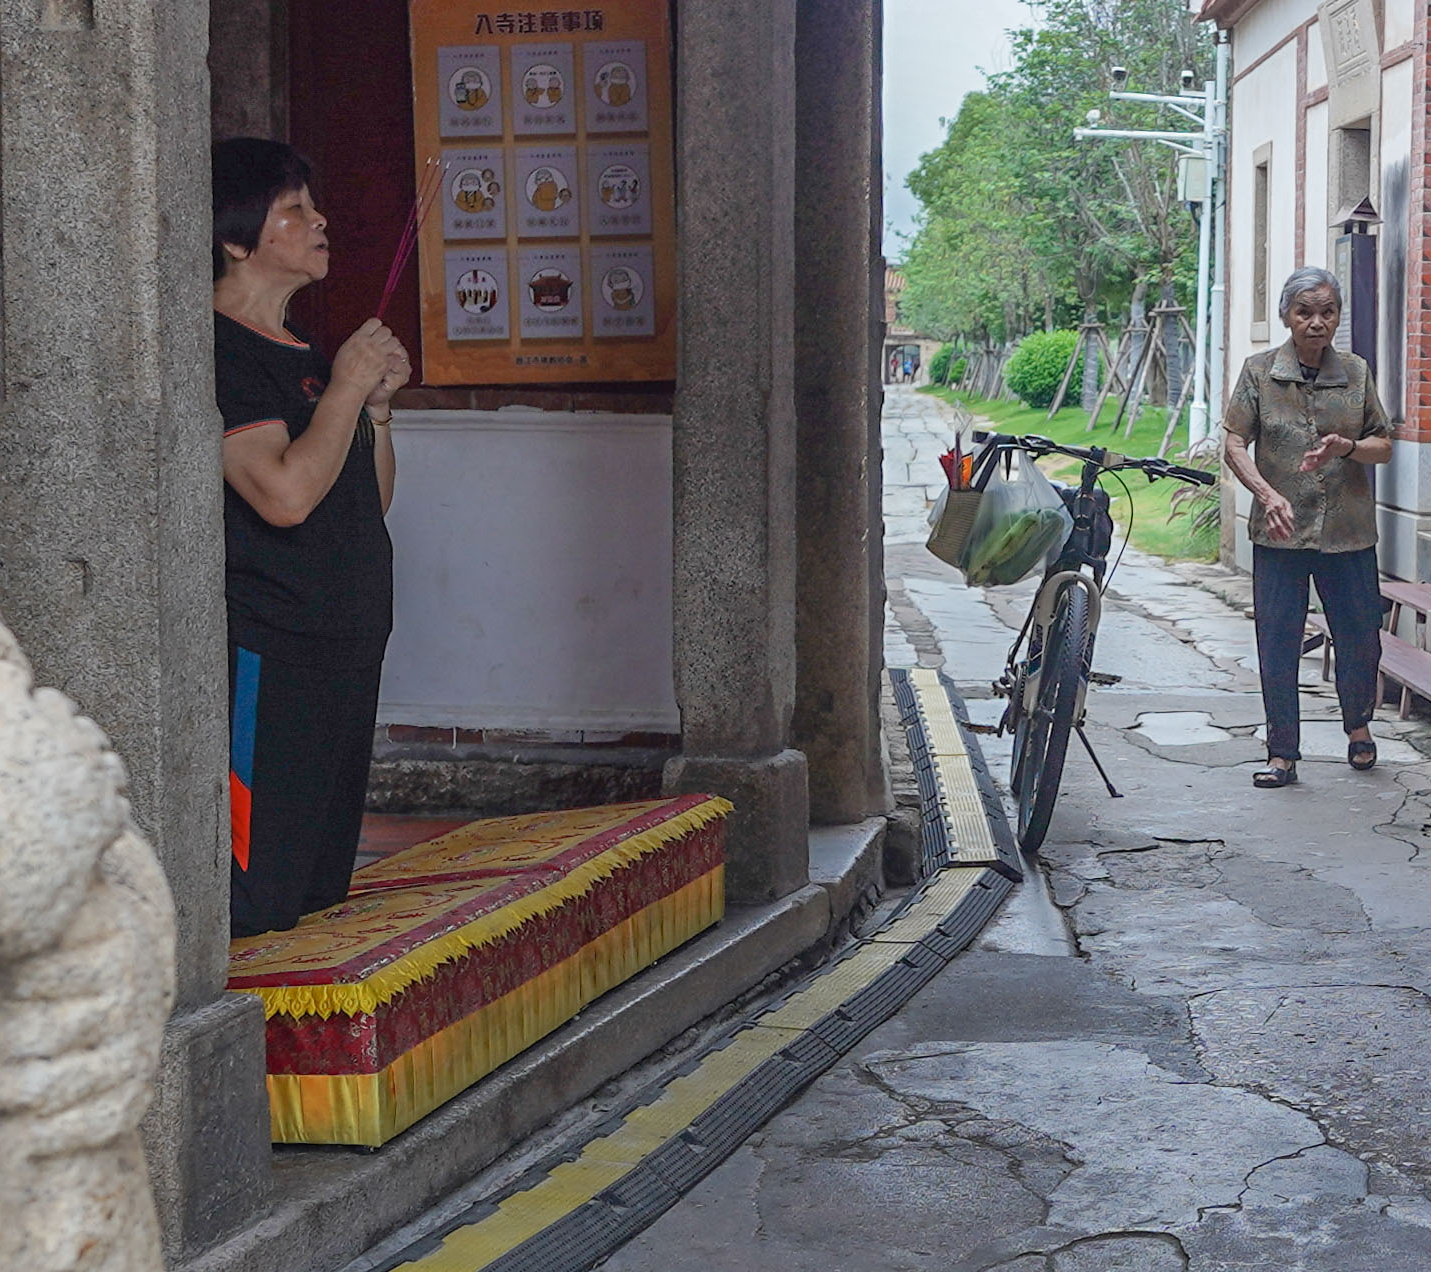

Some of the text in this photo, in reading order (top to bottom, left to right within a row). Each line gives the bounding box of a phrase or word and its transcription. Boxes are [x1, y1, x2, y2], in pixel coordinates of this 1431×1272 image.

[474, 10, 604, 35] 入寺注意事項
